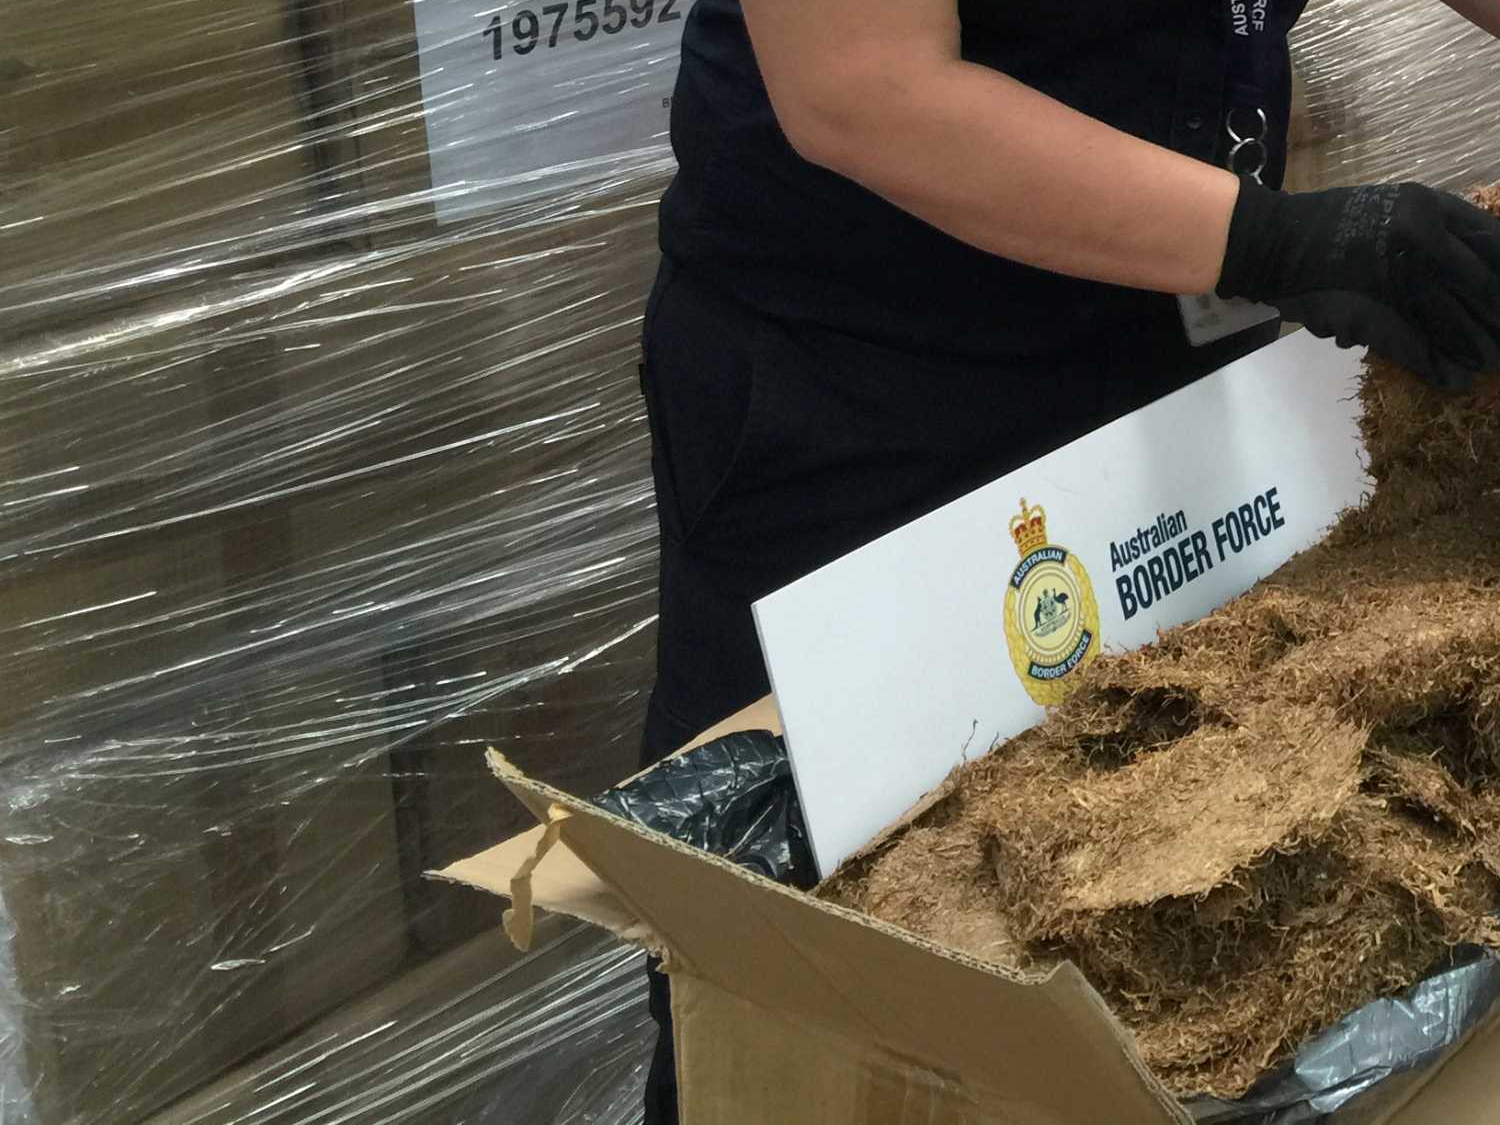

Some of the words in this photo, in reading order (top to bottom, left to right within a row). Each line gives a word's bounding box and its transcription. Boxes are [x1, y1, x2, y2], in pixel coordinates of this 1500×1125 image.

[1109, 509, 1188, 572] Australian
[1115, 530, 1214, 620] BORDER
[1212, 487, 1286, 562] FORCE
[1014, 549, 1063, 587] AUSTRALIAN
[1031, 661, 1067, 678] BORDER
[1068, 636, 1091, 669] FORCE
